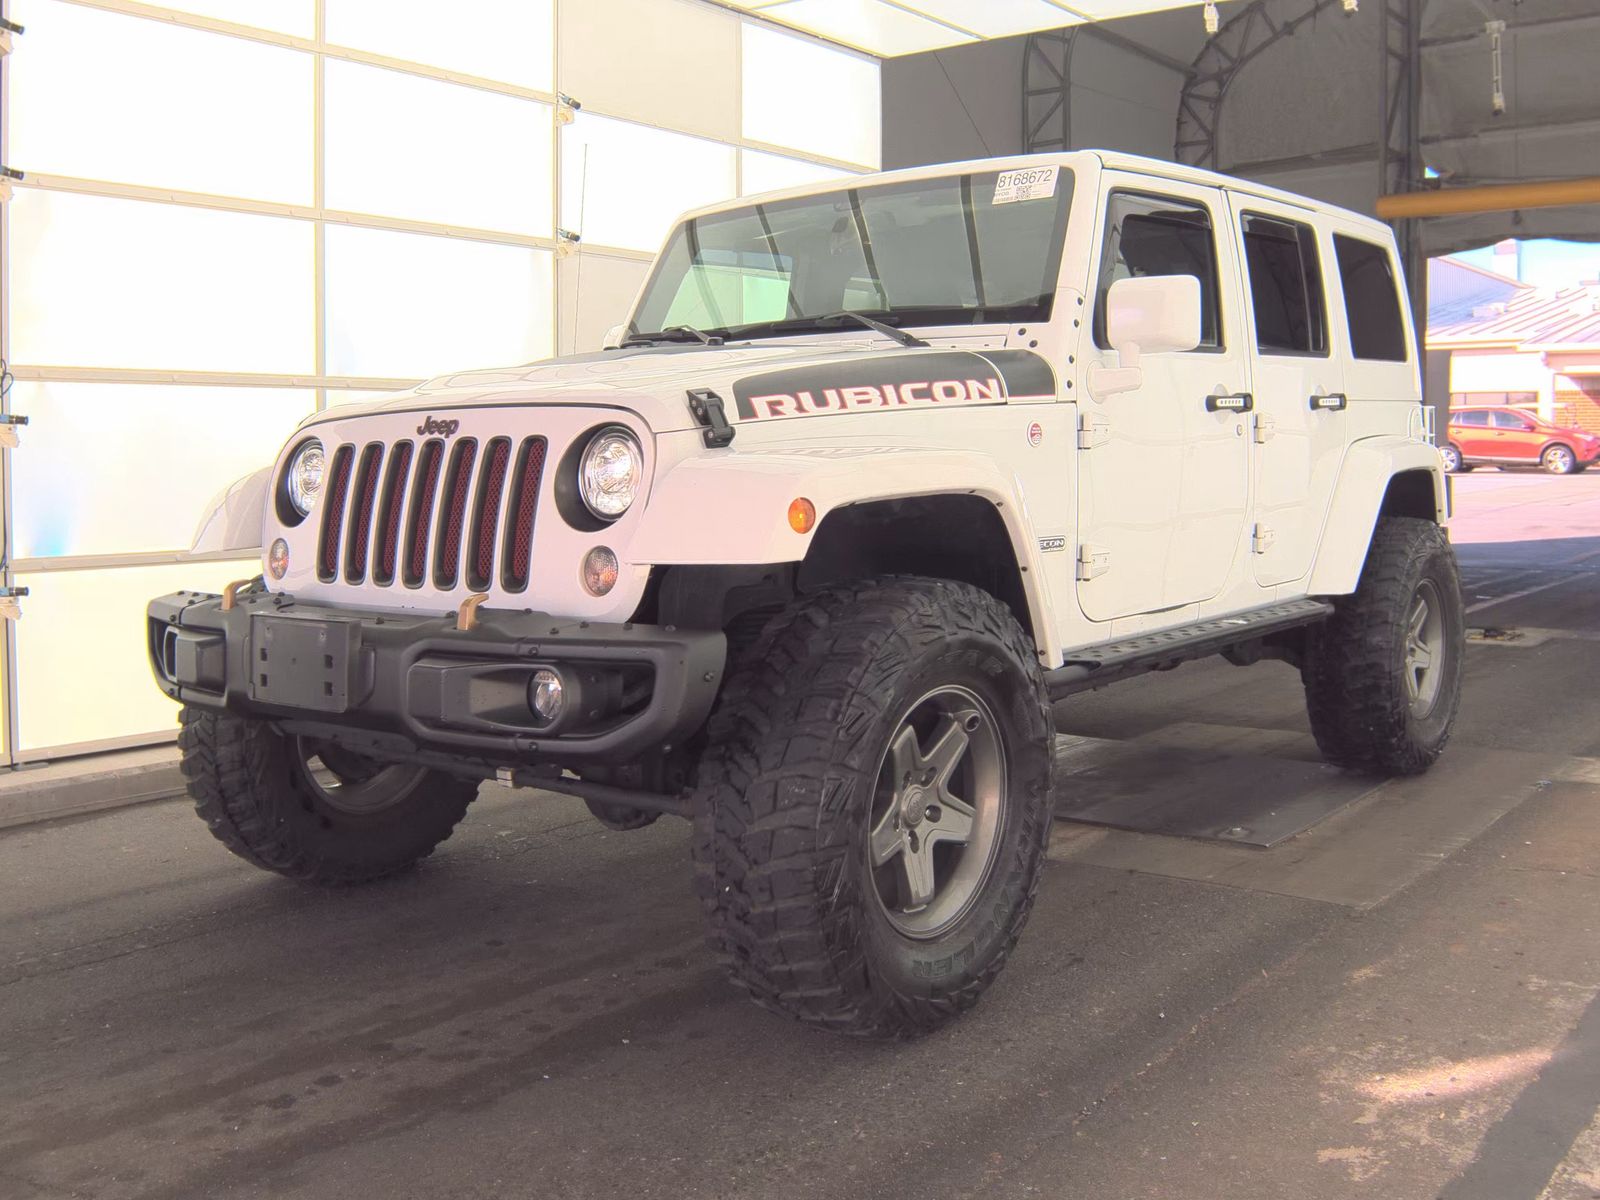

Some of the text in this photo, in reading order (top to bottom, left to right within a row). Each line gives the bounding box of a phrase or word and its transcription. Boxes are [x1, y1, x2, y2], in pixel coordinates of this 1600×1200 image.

[998, 169, 1053, 188] 8168672
[748, 378, 1001, 419] RUBICON
[416, 415, 459, 438] Jeep
